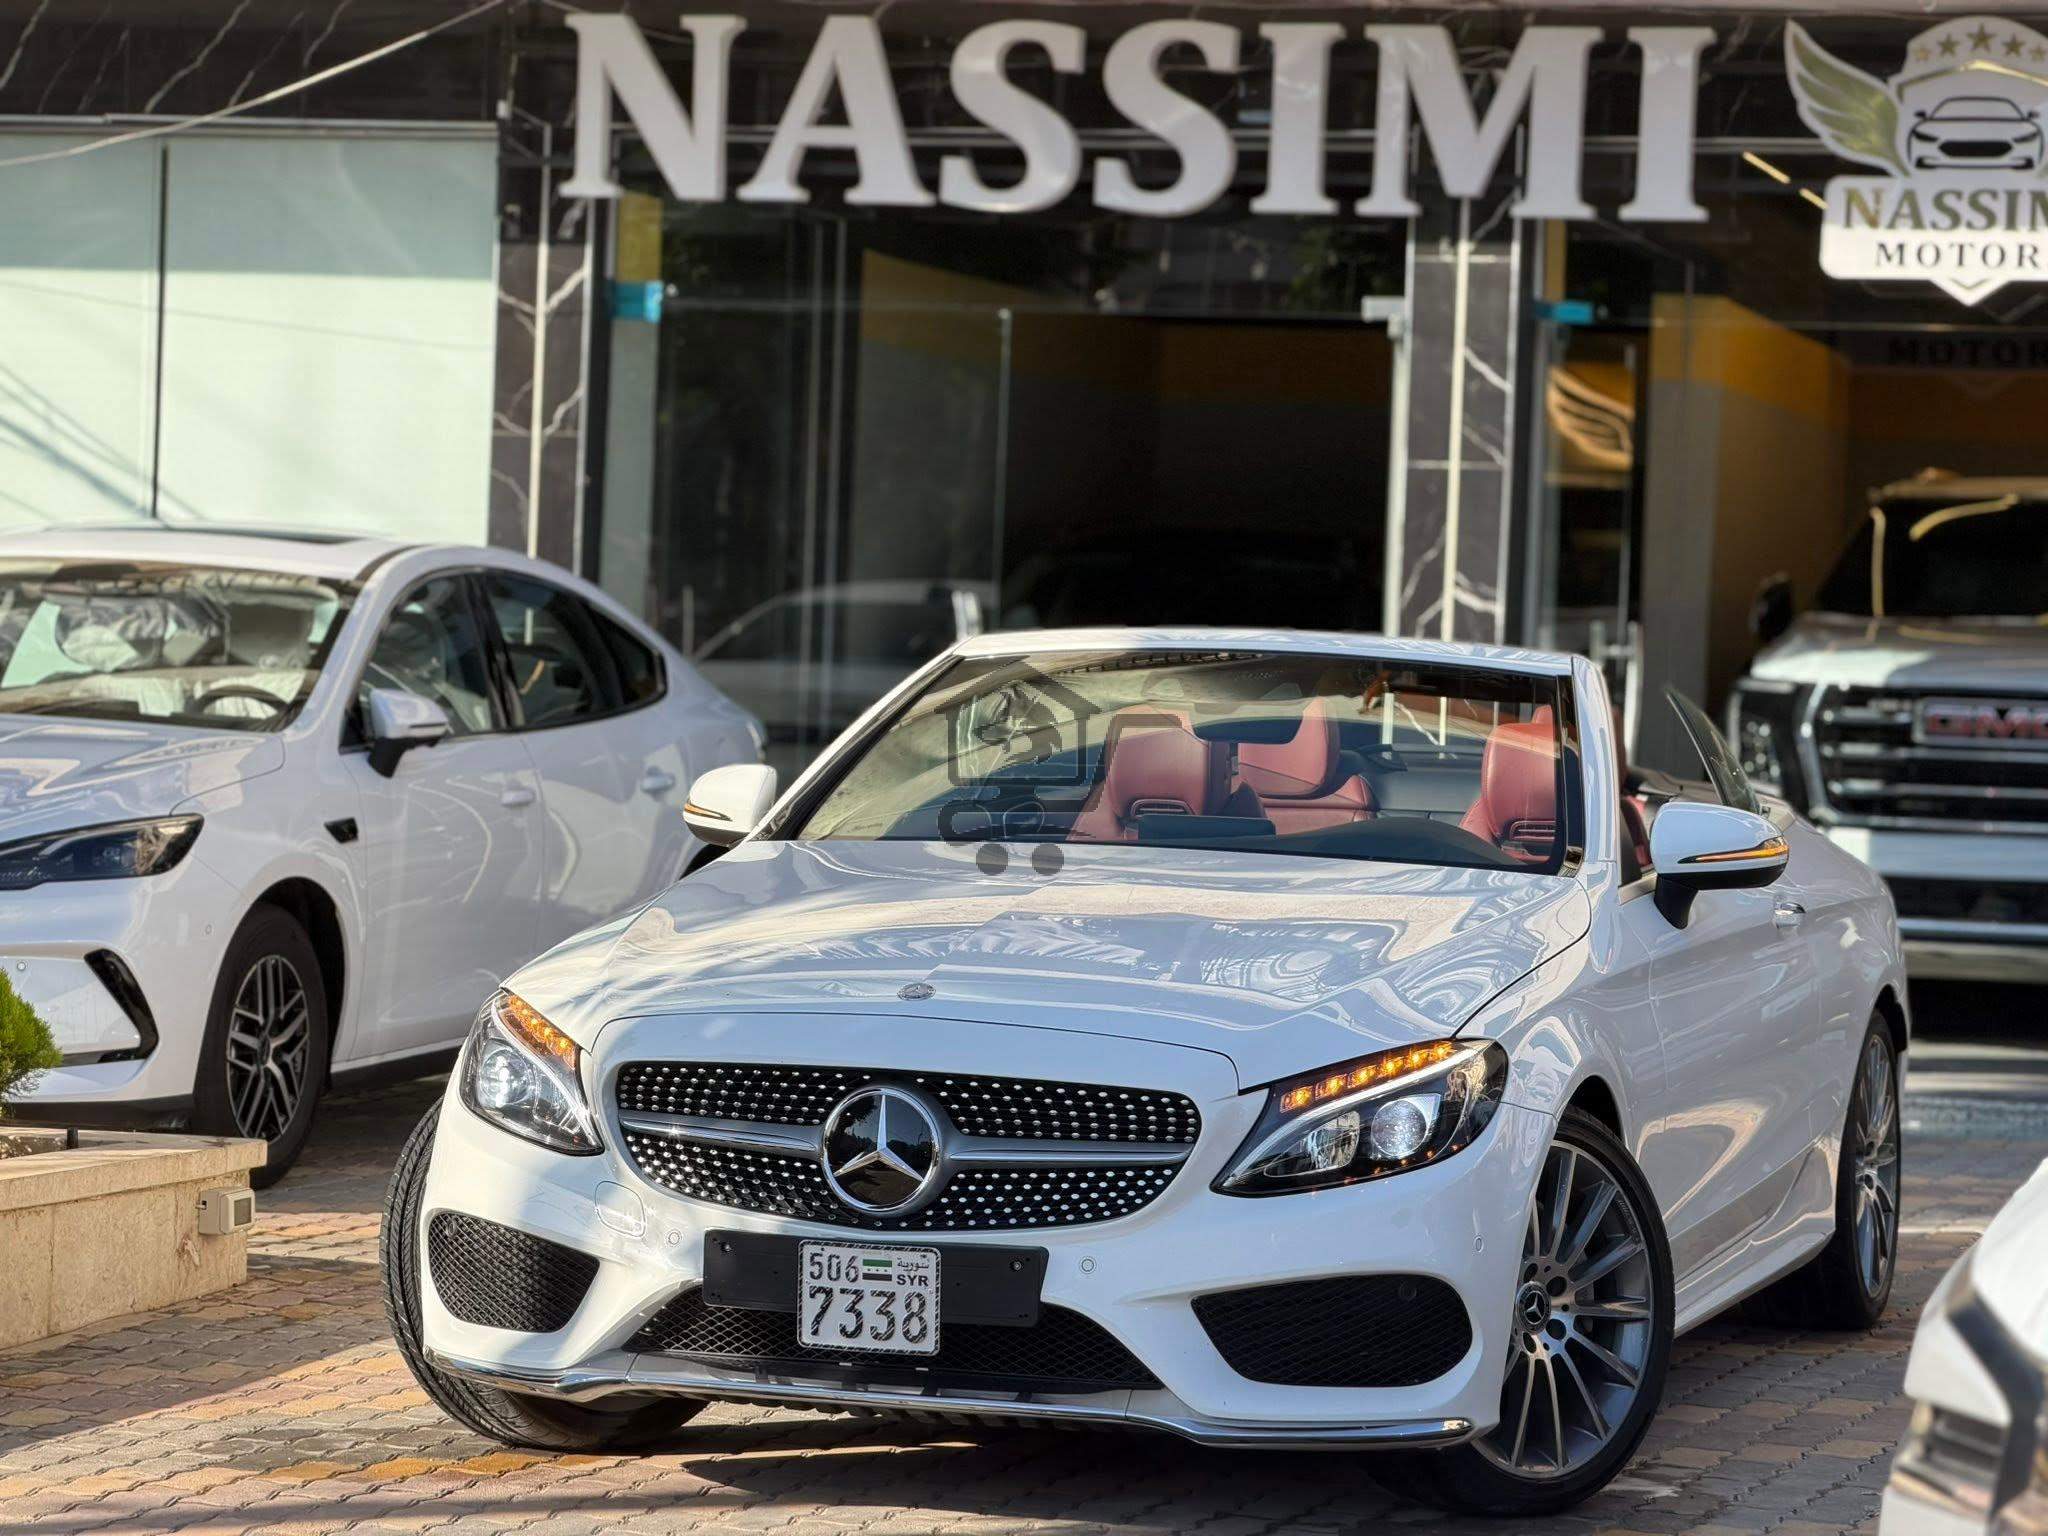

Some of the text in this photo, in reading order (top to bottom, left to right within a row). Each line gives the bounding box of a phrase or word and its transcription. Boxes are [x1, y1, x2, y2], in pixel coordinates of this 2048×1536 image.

[559, 13, 1717, 222] NASSIMI
[809, 1253, 860, 1283] 506
[896, 1256, 930, 1271] سورية
[896, 1274, 929, 1287] SYR
[808, 1286, 928, 1343] 7338
